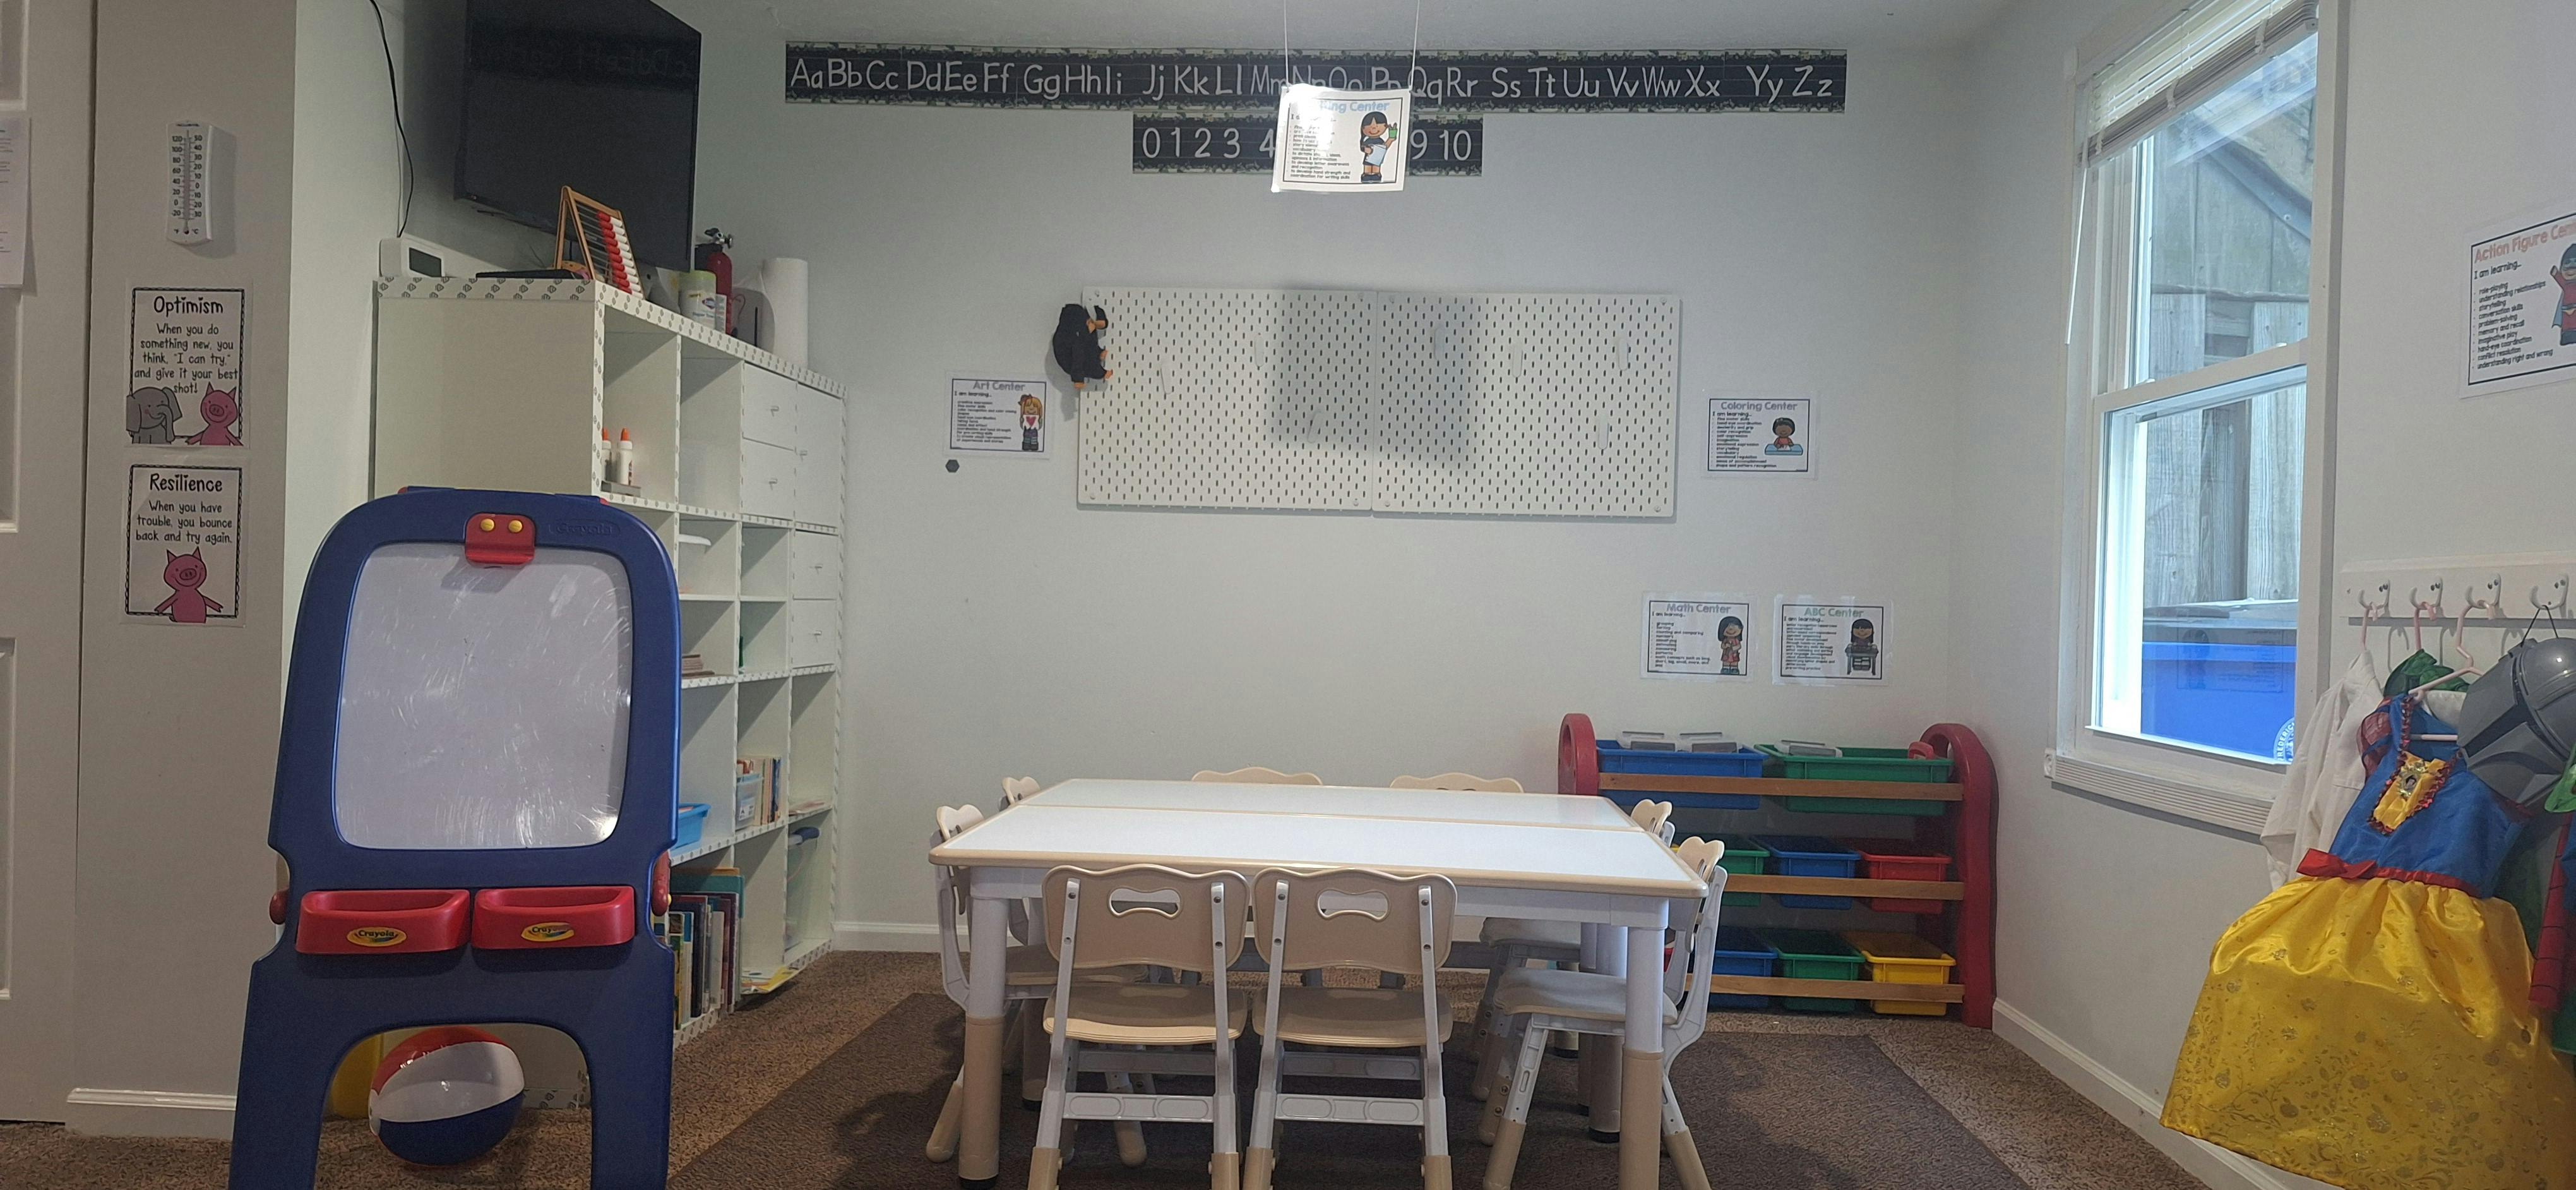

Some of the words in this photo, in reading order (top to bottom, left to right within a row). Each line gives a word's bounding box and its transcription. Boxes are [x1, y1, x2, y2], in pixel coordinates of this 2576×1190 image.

[1024, 65, 1059, 100] Gg
[1143, 64, 1164, 101] Jj
[1491, 68, 1520, 98] Ss
[1528, 67, 1555, 97] Tt
[1563, 68, 1599, 97] Uu
[1607, 67, 1638, 97] Vv
[1642, 66, 1680, 97] Ww
[1685, 66, 1720, 96] Xx
[1746, 65, 1783, 102] Yy
[1792, 66, 1832, 96] Zz
[1350, 101, 1390, 111] Center
[1143, 128, 1160, 158] 0
[1171, 128, 1180, 157] 1
[1195, 129, 1211, 157] 2
[1224, 128, 1239, 158] 3
[1440, 129, 1471, 159] 10
[2474, 243, 2509, 264] Action
[2512, 231, 2548, 253] Figure
[2474, 270, 2478, 279] I
[2480, 269, 2489, 278] am
[2479, 282, 2508, 294] role-playing
[154, 296, 223, 316] Optimism
[157, 323, 182, 334] When
[187, 326, 203, 336] you
[208, 323, 218, 334] do
[2500, 322, 2509, 331] and
[2507, 331, 2518, 340] play
[141, 338, 188, 351] something
[217, 342, 233, 351] you
[2512, 353, 2524, 363] right
[2525, 352, 2534, 361] and
[135, 368, 150, 378] and
[156, 368, 174, 380] give
[180, 368, 187, 378] it
[192, 371, 212, 380] your
[218, 369, 238, 379] best
[174, 382, 197, 394] shot!
[973, 382, 989, 390] Art
[993, 382, 1025, 391] Center
[1721, 402, 1762, 411] Coloring
[1765, 402, 1797, 411] Center
[150, 473, 222, 491] Resilience
[149, 500, 174, 512] When
[179, 503, 196, 514] you
[201, 502, 222, 513] have
[178, 519, 194, 529] you
[200, 517, 232, 527] bounce
[136, 530, 158, 541] back
[164, 531, 181, 541] and
[186, 531, 200, 544] try
[1667, 604, 1693, 612] Math
[1696, 604, 1731, 613] Center
[1804, 608, 1825, 616] ABC
[1828, 608, 1864, 617] Center
[358, 929, 395, 938] Crayola
